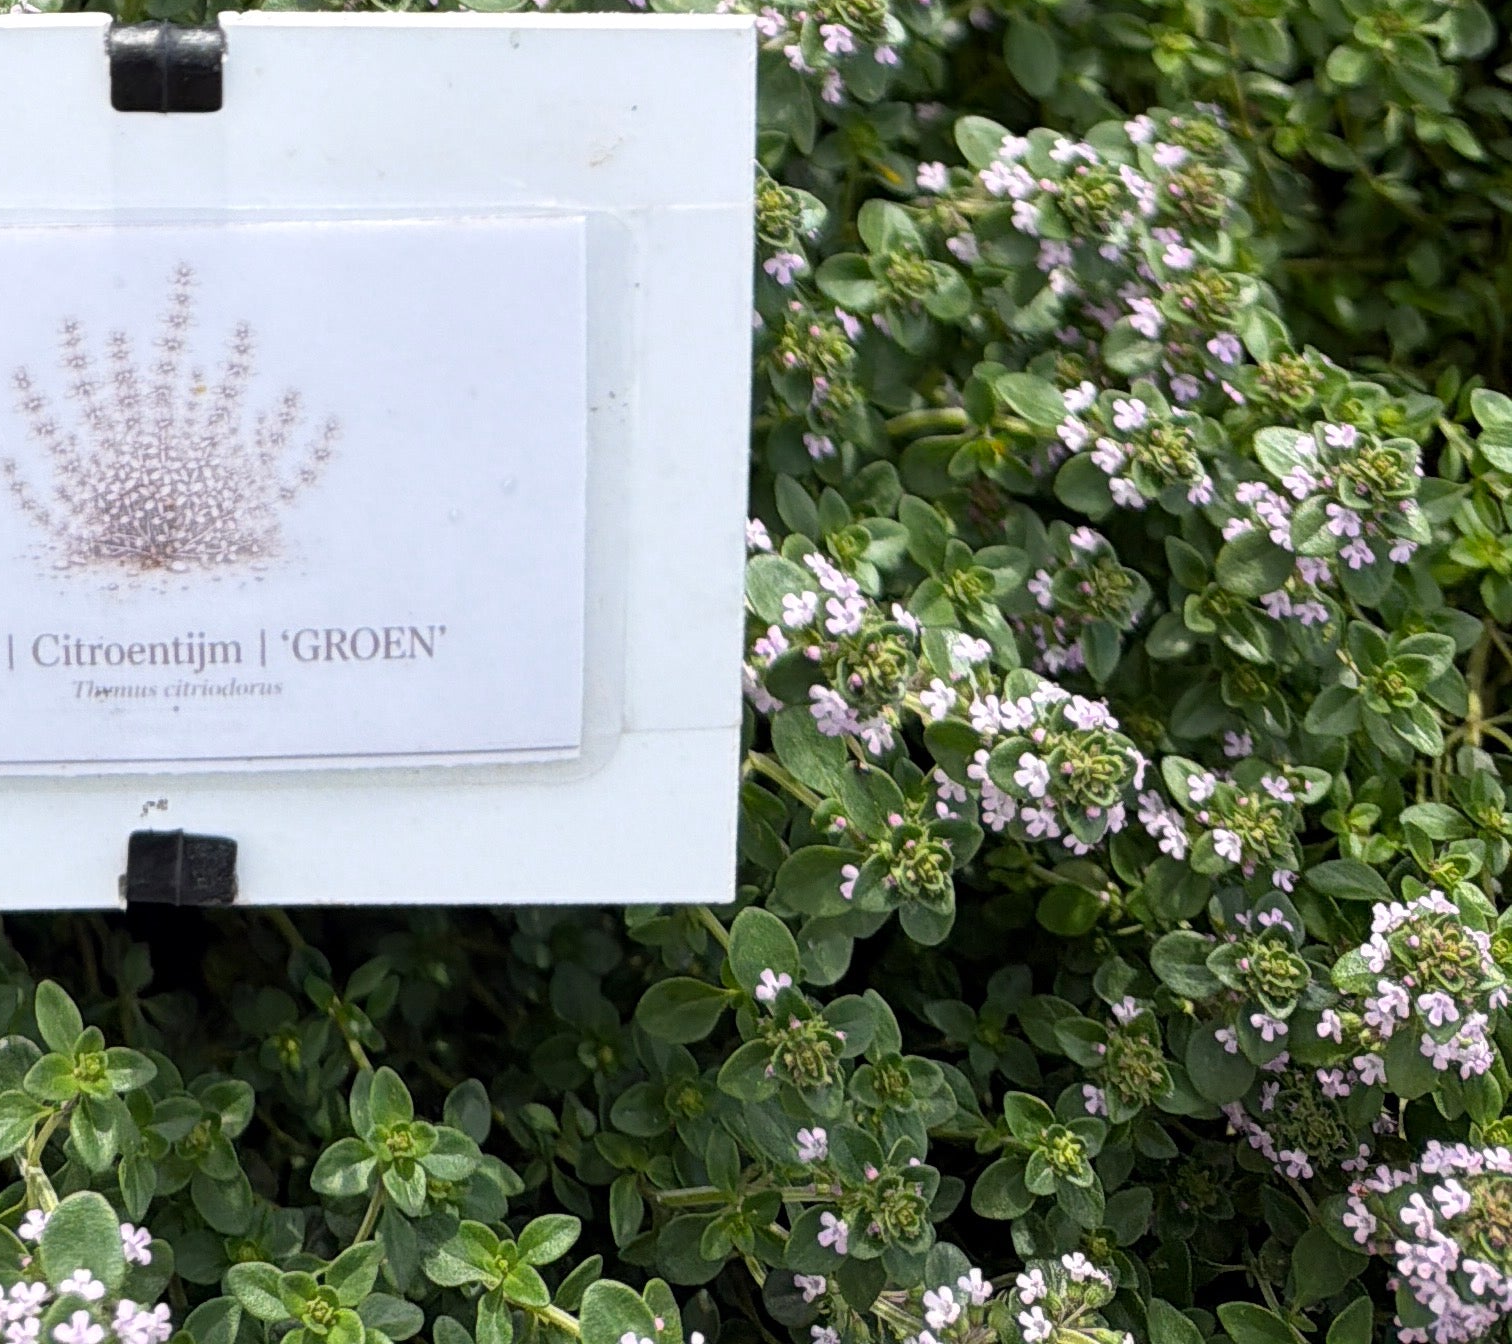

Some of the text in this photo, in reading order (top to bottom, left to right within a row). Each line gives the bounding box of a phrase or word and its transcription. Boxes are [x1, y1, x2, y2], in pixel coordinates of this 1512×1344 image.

[7, 633, 15, 672] |
[31, 631, 243, 675] Citroentijm
[259, 628, 267, 668] |
[72, 677, 283, 699] Thymus citriodorus
